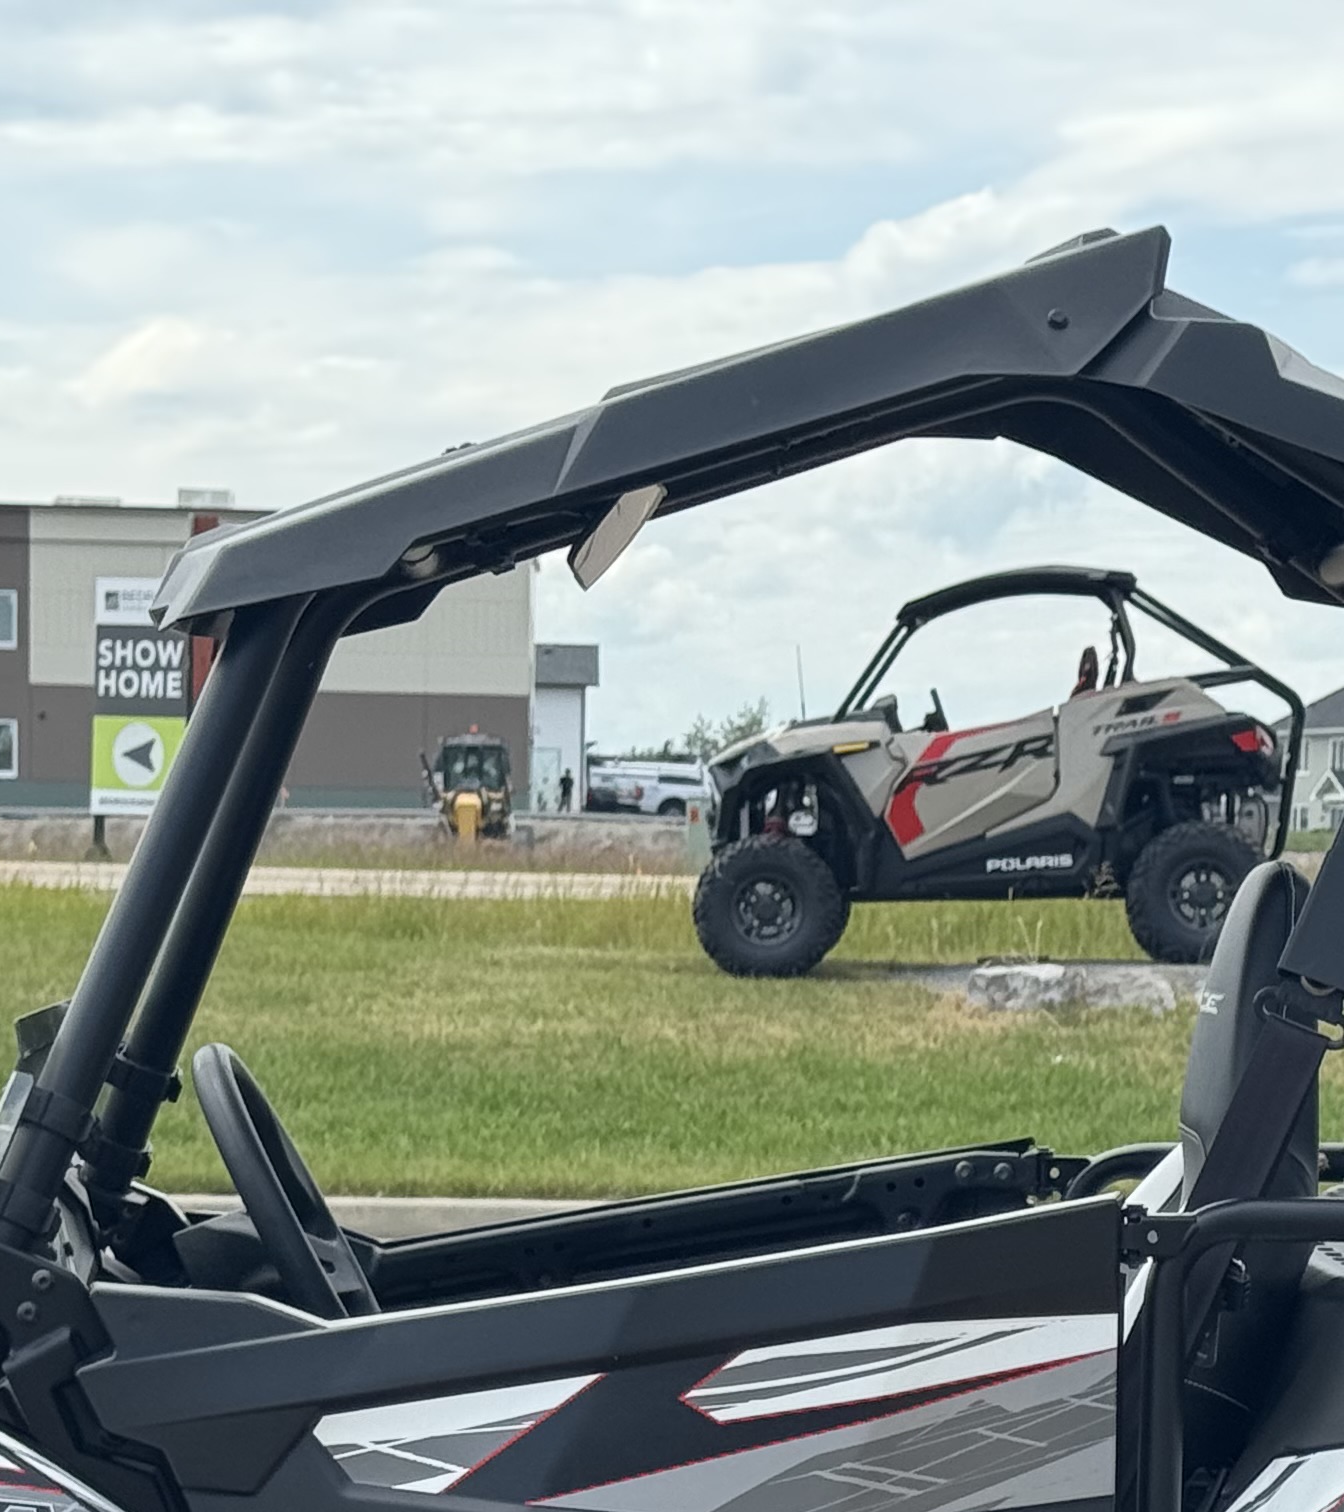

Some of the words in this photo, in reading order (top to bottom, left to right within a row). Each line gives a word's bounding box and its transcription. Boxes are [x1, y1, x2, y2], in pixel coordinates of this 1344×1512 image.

[98, 638, 185, 669] SHOW
[98, 669, 183, 699] HOME
[985, 853, 1074, 874] POLARIS
